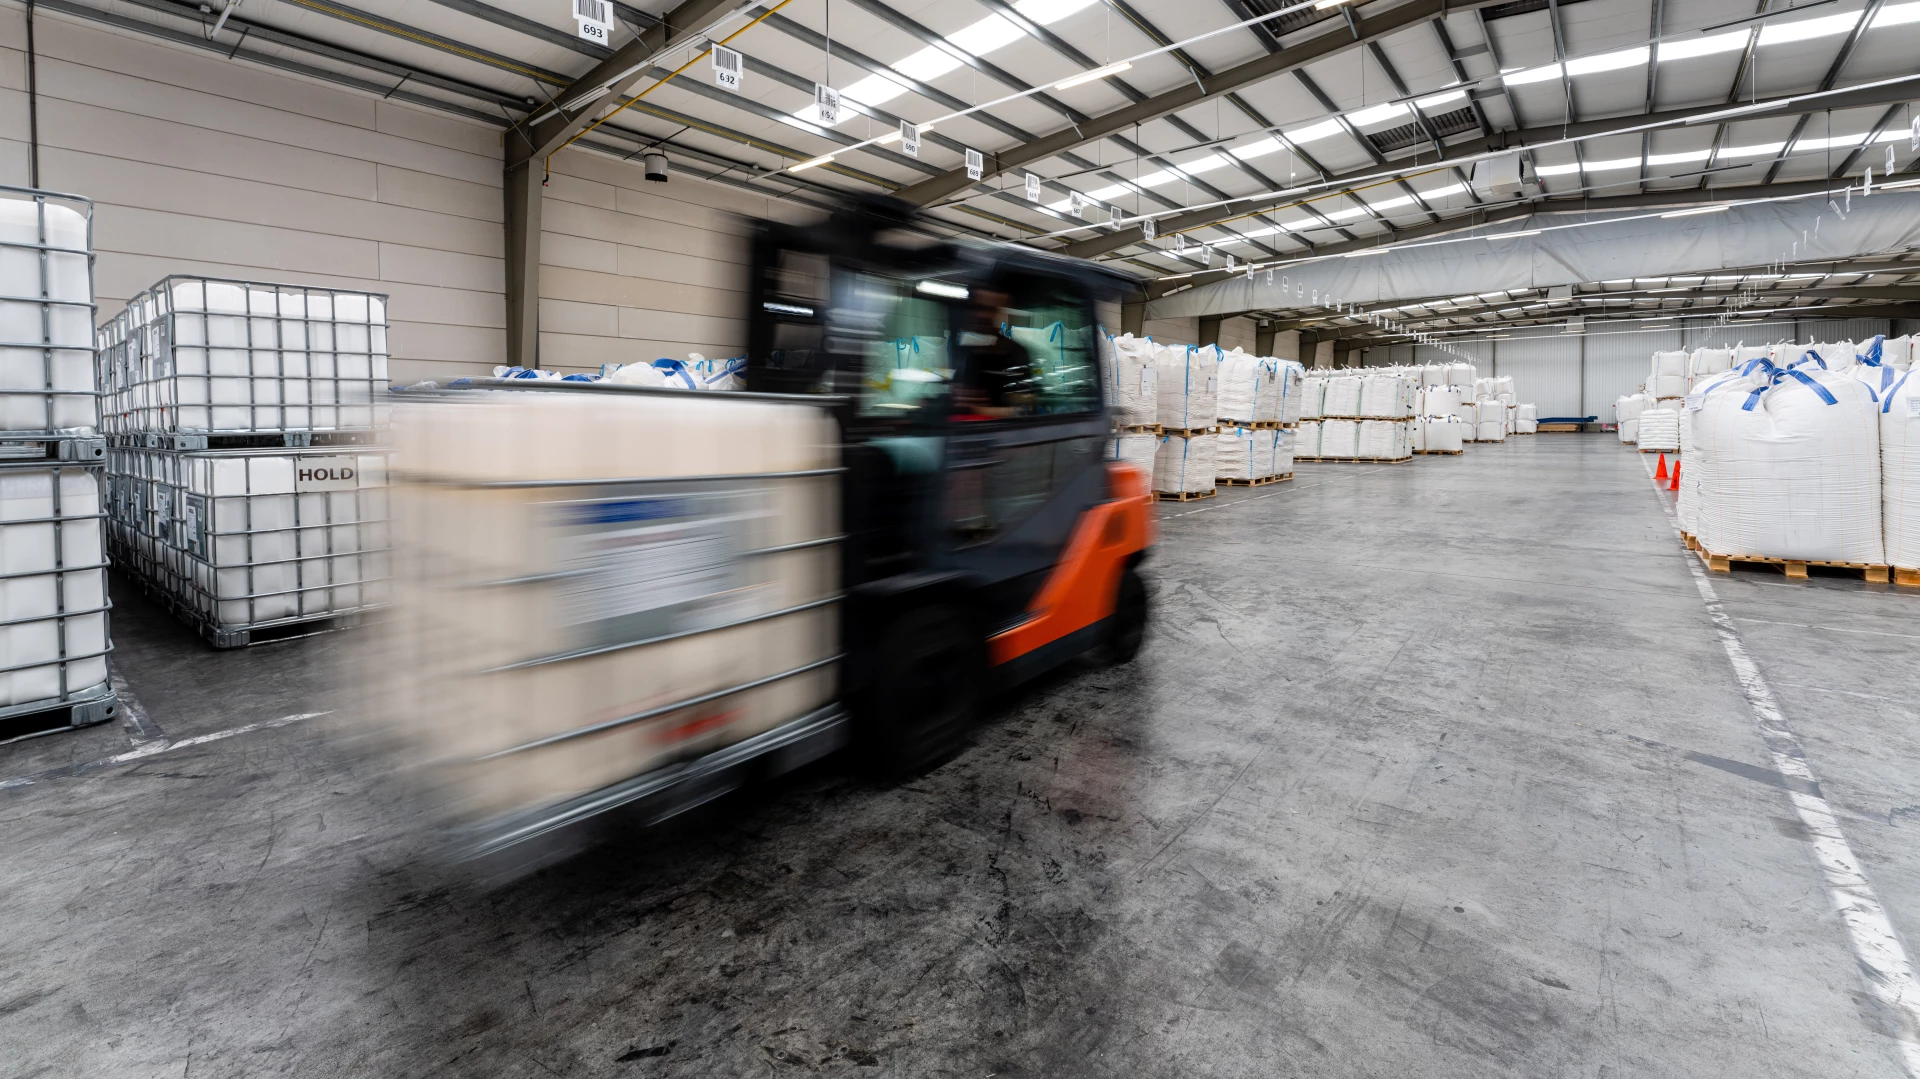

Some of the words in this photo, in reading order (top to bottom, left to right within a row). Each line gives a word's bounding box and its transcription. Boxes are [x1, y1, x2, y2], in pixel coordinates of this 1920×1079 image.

[583, 24, 603, 38] 693
[719, 72, 735, 85] 692
[298, 467, 355, 482] HOLD
